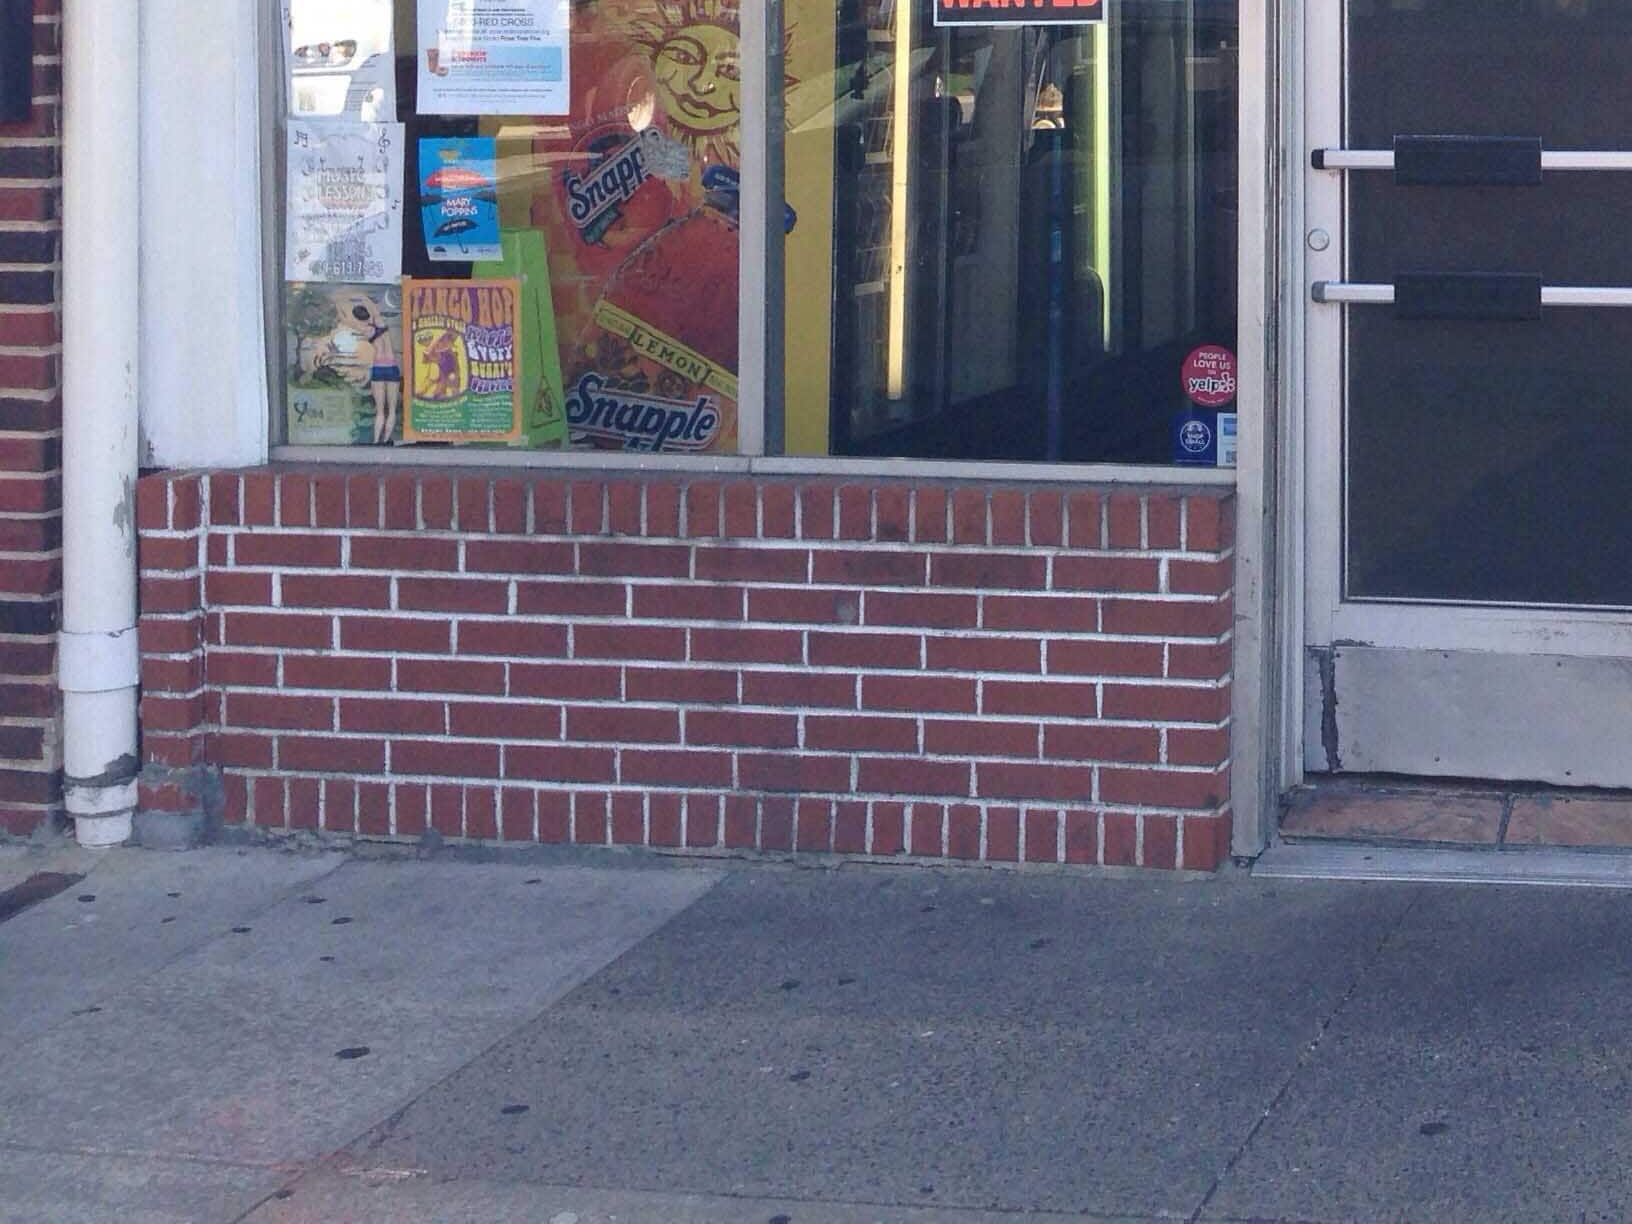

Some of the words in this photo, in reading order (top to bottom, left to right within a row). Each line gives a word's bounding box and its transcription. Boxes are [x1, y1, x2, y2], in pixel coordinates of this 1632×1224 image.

[446, 197, 472, 206] MARY
[441, 206, 478, 216] POPPINS
[633, 329, 703, 378] LEMON
[1198, 352, 1227, 361] PEOPLE
[1193, 360, 1217, 368] LOVE
[1219, 361, 1231, 369] US
[1189, 377, 1220, 393] yelp
[566, 373, 717, 453] Snapple
